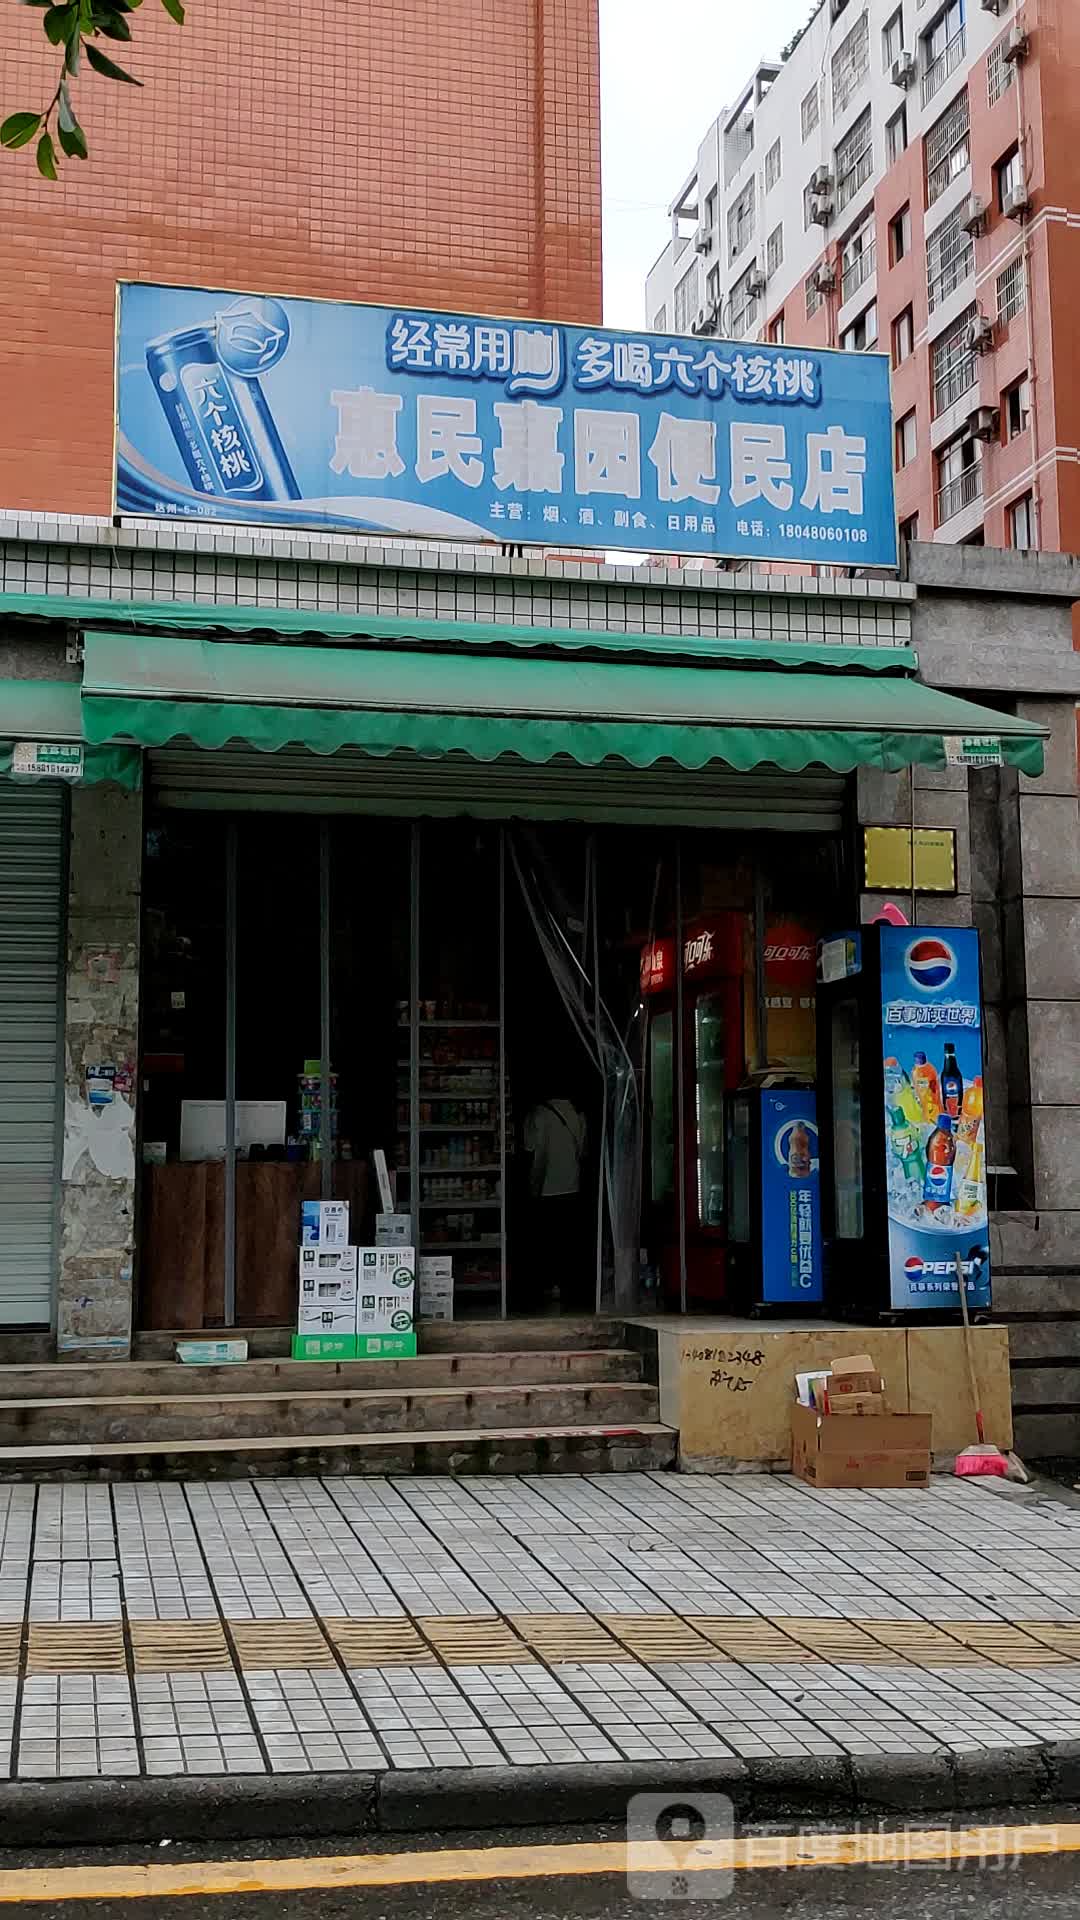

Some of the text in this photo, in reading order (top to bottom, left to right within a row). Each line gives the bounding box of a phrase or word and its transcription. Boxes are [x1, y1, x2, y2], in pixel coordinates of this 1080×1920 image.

[391, 318, 815, 398] 经常用脑 多喝六个核桃
[193, 377, 252, 479] 六个核桃
[329, 385, 867, 515] 惠民嘉园便民店
[887, 1006, 977, 1025] 百事冰爽世界
[910, 1281, 976, 1293] 百事系列荣誉品
[921, 1260, 974, 1275] PEPSI
